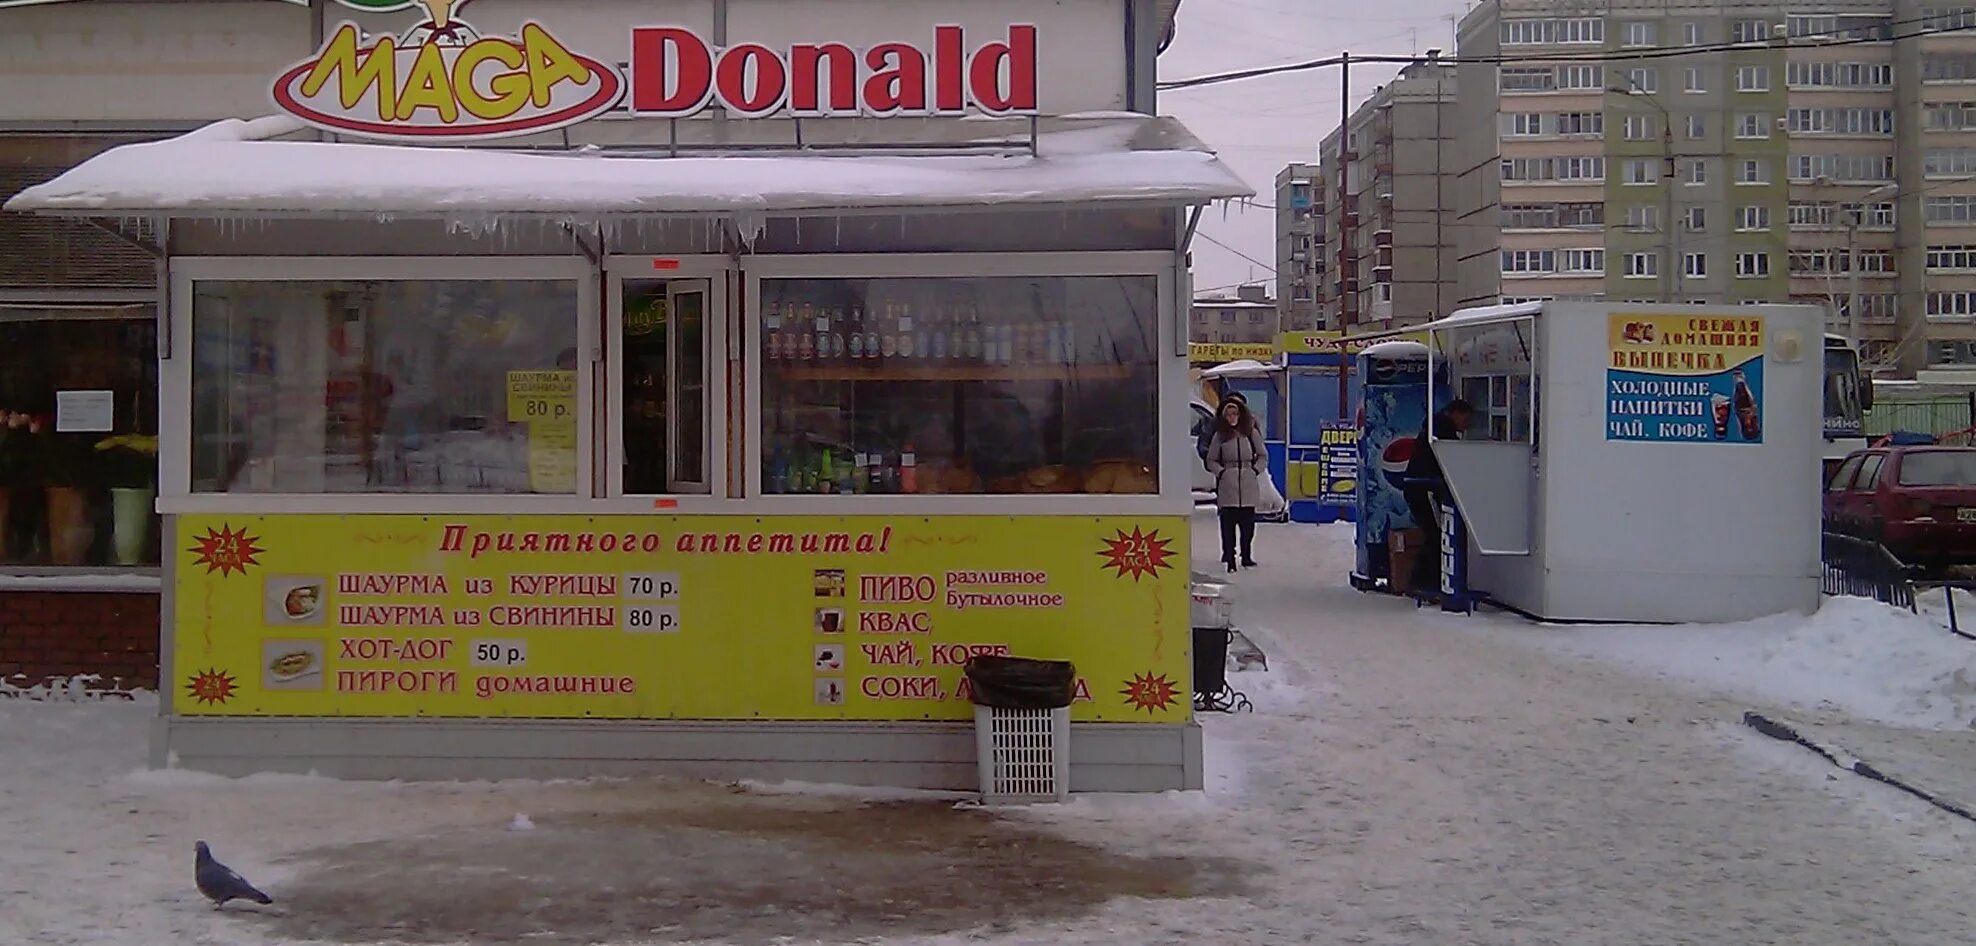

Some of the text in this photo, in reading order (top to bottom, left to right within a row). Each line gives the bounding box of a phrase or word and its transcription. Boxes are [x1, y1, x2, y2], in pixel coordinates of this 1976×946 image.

[300, 22, 1039, 123] MAGA Donald
[1688, 318, 1760, 332] СВЕЖАЯ
[1660, 332, 1760, 347] ДОМАШНЯЯ
[1612, 351, 1727, 369] ВЫПЕЧКА
[1611, 380, 1710, 397] ХОЛОДНЫЕ
[526, 401, 571, 420] 80 р.
[1611, 400, 1703, 416] НАПИТКИ
[1659, 422, 1708, 438] КОФЕ
[214, 537, 239, 553] 24
[439, 524, 893, 558] Приятного аппетита!
[1124, 540, 1151, 556] 24
[1441, 504, 1455, 595] PEPSI
[1118, 556, 1153, 567] ЧАСА
[338, 574, 679, 599] ШАУРМА из КУРИЦЫ 70 р.
[946, 571, 1046, 587] разливное
[859, 576, 937, 602] ПИВО
[340, 605, 679, 631] ШАУРМА из СВИНИНЫ 80 р.
[340, 638, 525, 665] ХОТ-ДОГ 50 р.
[862, 641, 923, 667] ЧАЙ,
[337, 671, 635, 698] ПИРОГИ домашние
[862, 676, 946, 699] СОКИ,
[1140, 681, 1161, 695] 24
